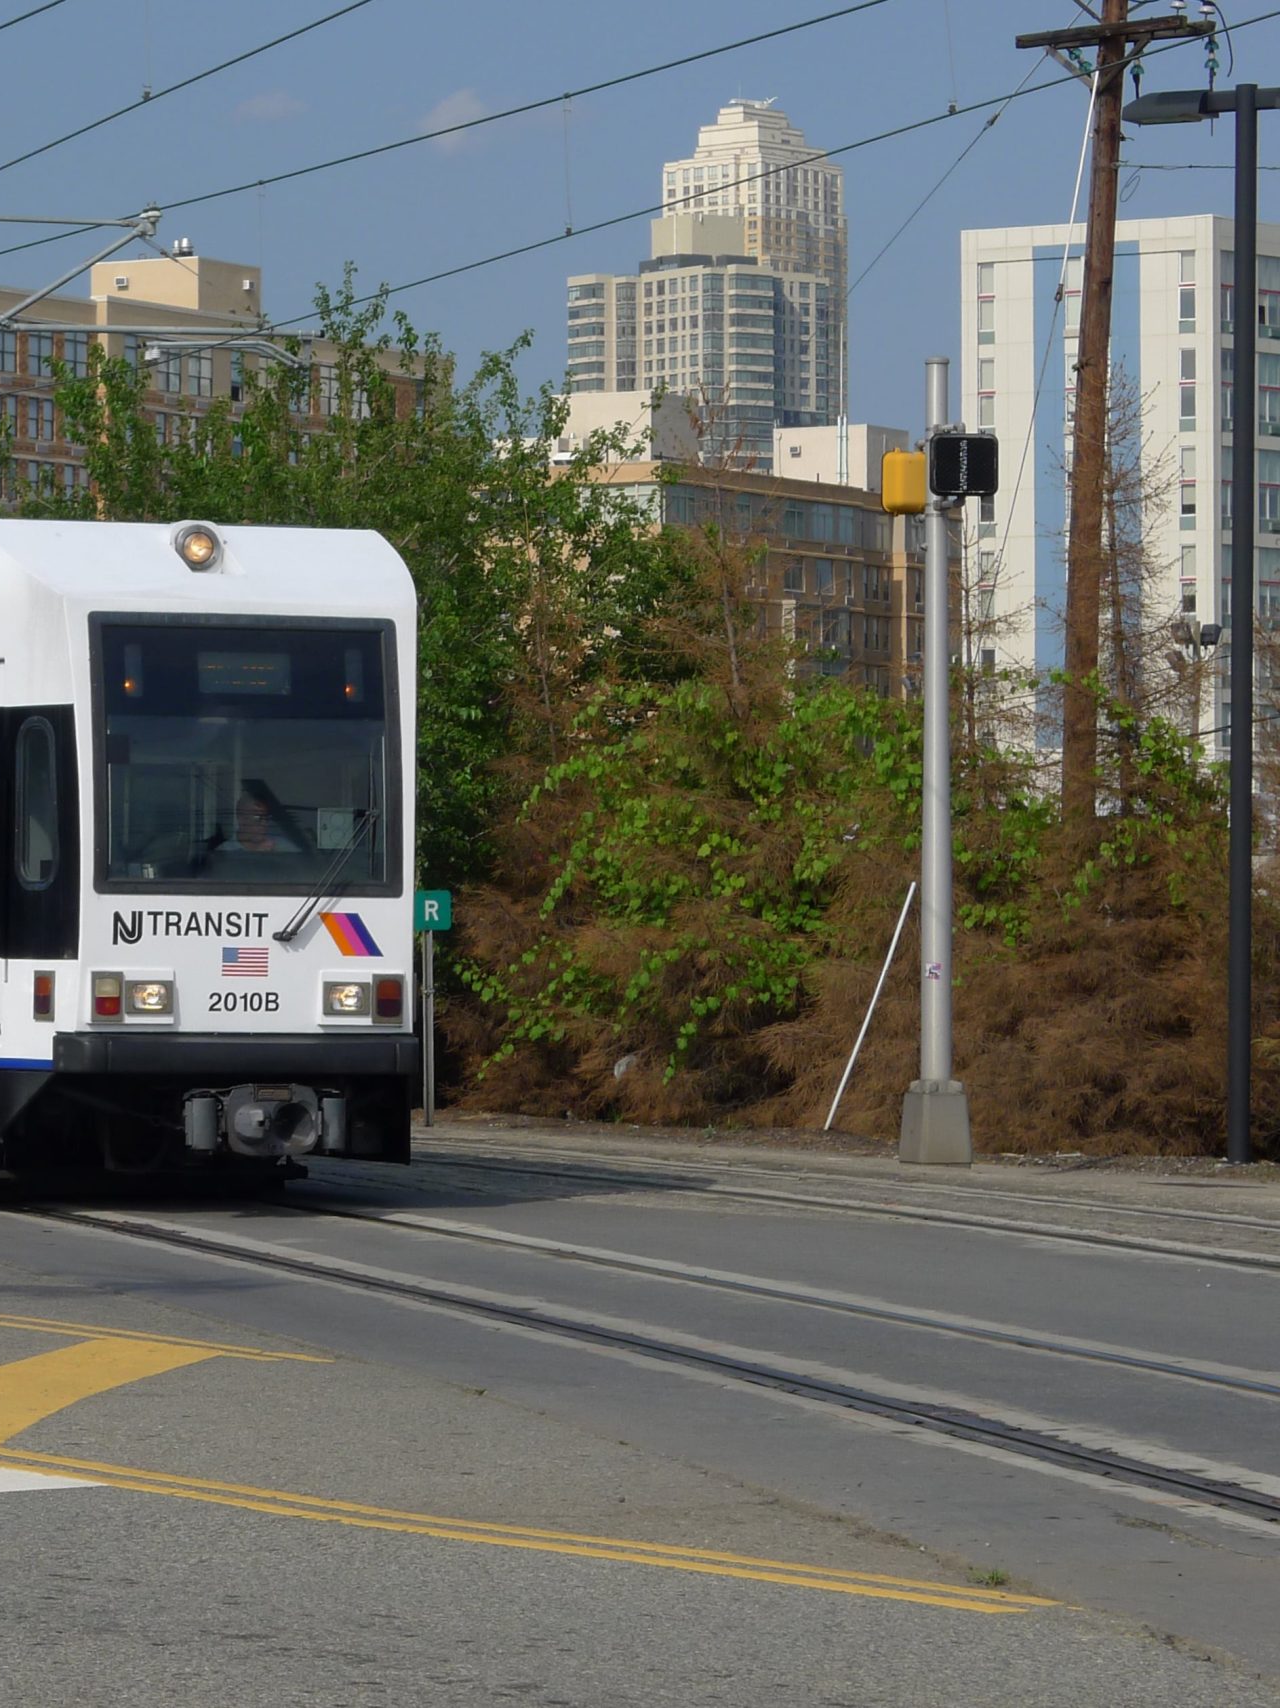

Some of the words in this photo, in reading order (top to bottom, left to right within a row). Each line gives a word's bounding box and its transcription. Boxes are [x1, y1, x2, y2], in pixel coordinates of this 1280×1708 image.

[424, 900, 439, 921] R
[112, 910, 143, 945] NJ
[147, 911, 269, 938] TRANSIT
[208, 992, 280, 1012] 2010B
